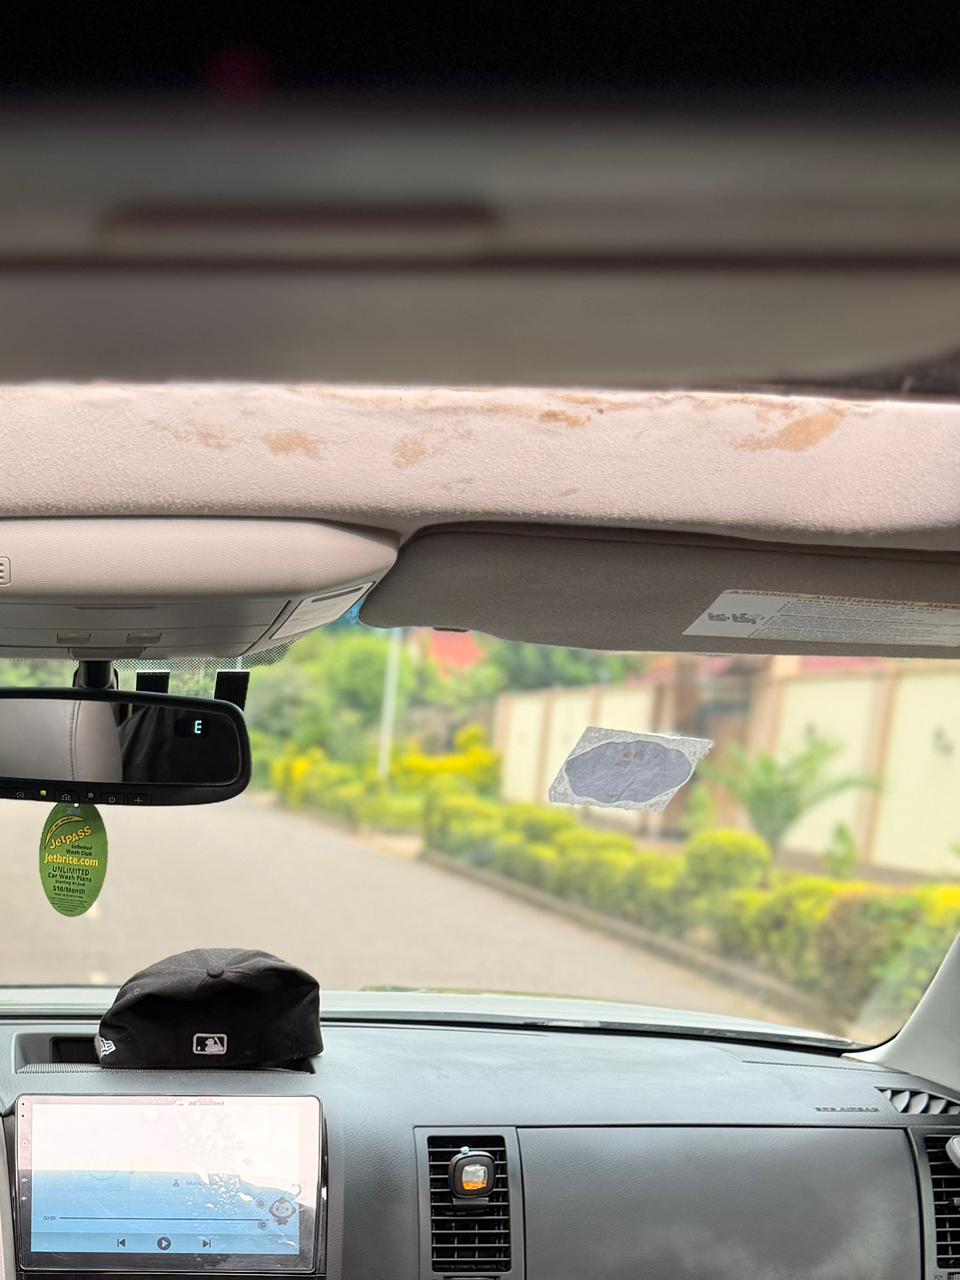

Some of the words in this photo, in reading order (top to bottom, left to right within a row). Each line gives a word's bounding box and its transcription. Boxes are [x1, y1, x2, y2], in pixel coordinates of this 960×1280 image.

[194, 720, 202, 734] E
[44, 853, 99, 867] Jetbrite.com
[48, 871, 58, 879] Car
[59, 872, 75, 880] Wash
[52, 865, 90, 876] UNLIMITED
